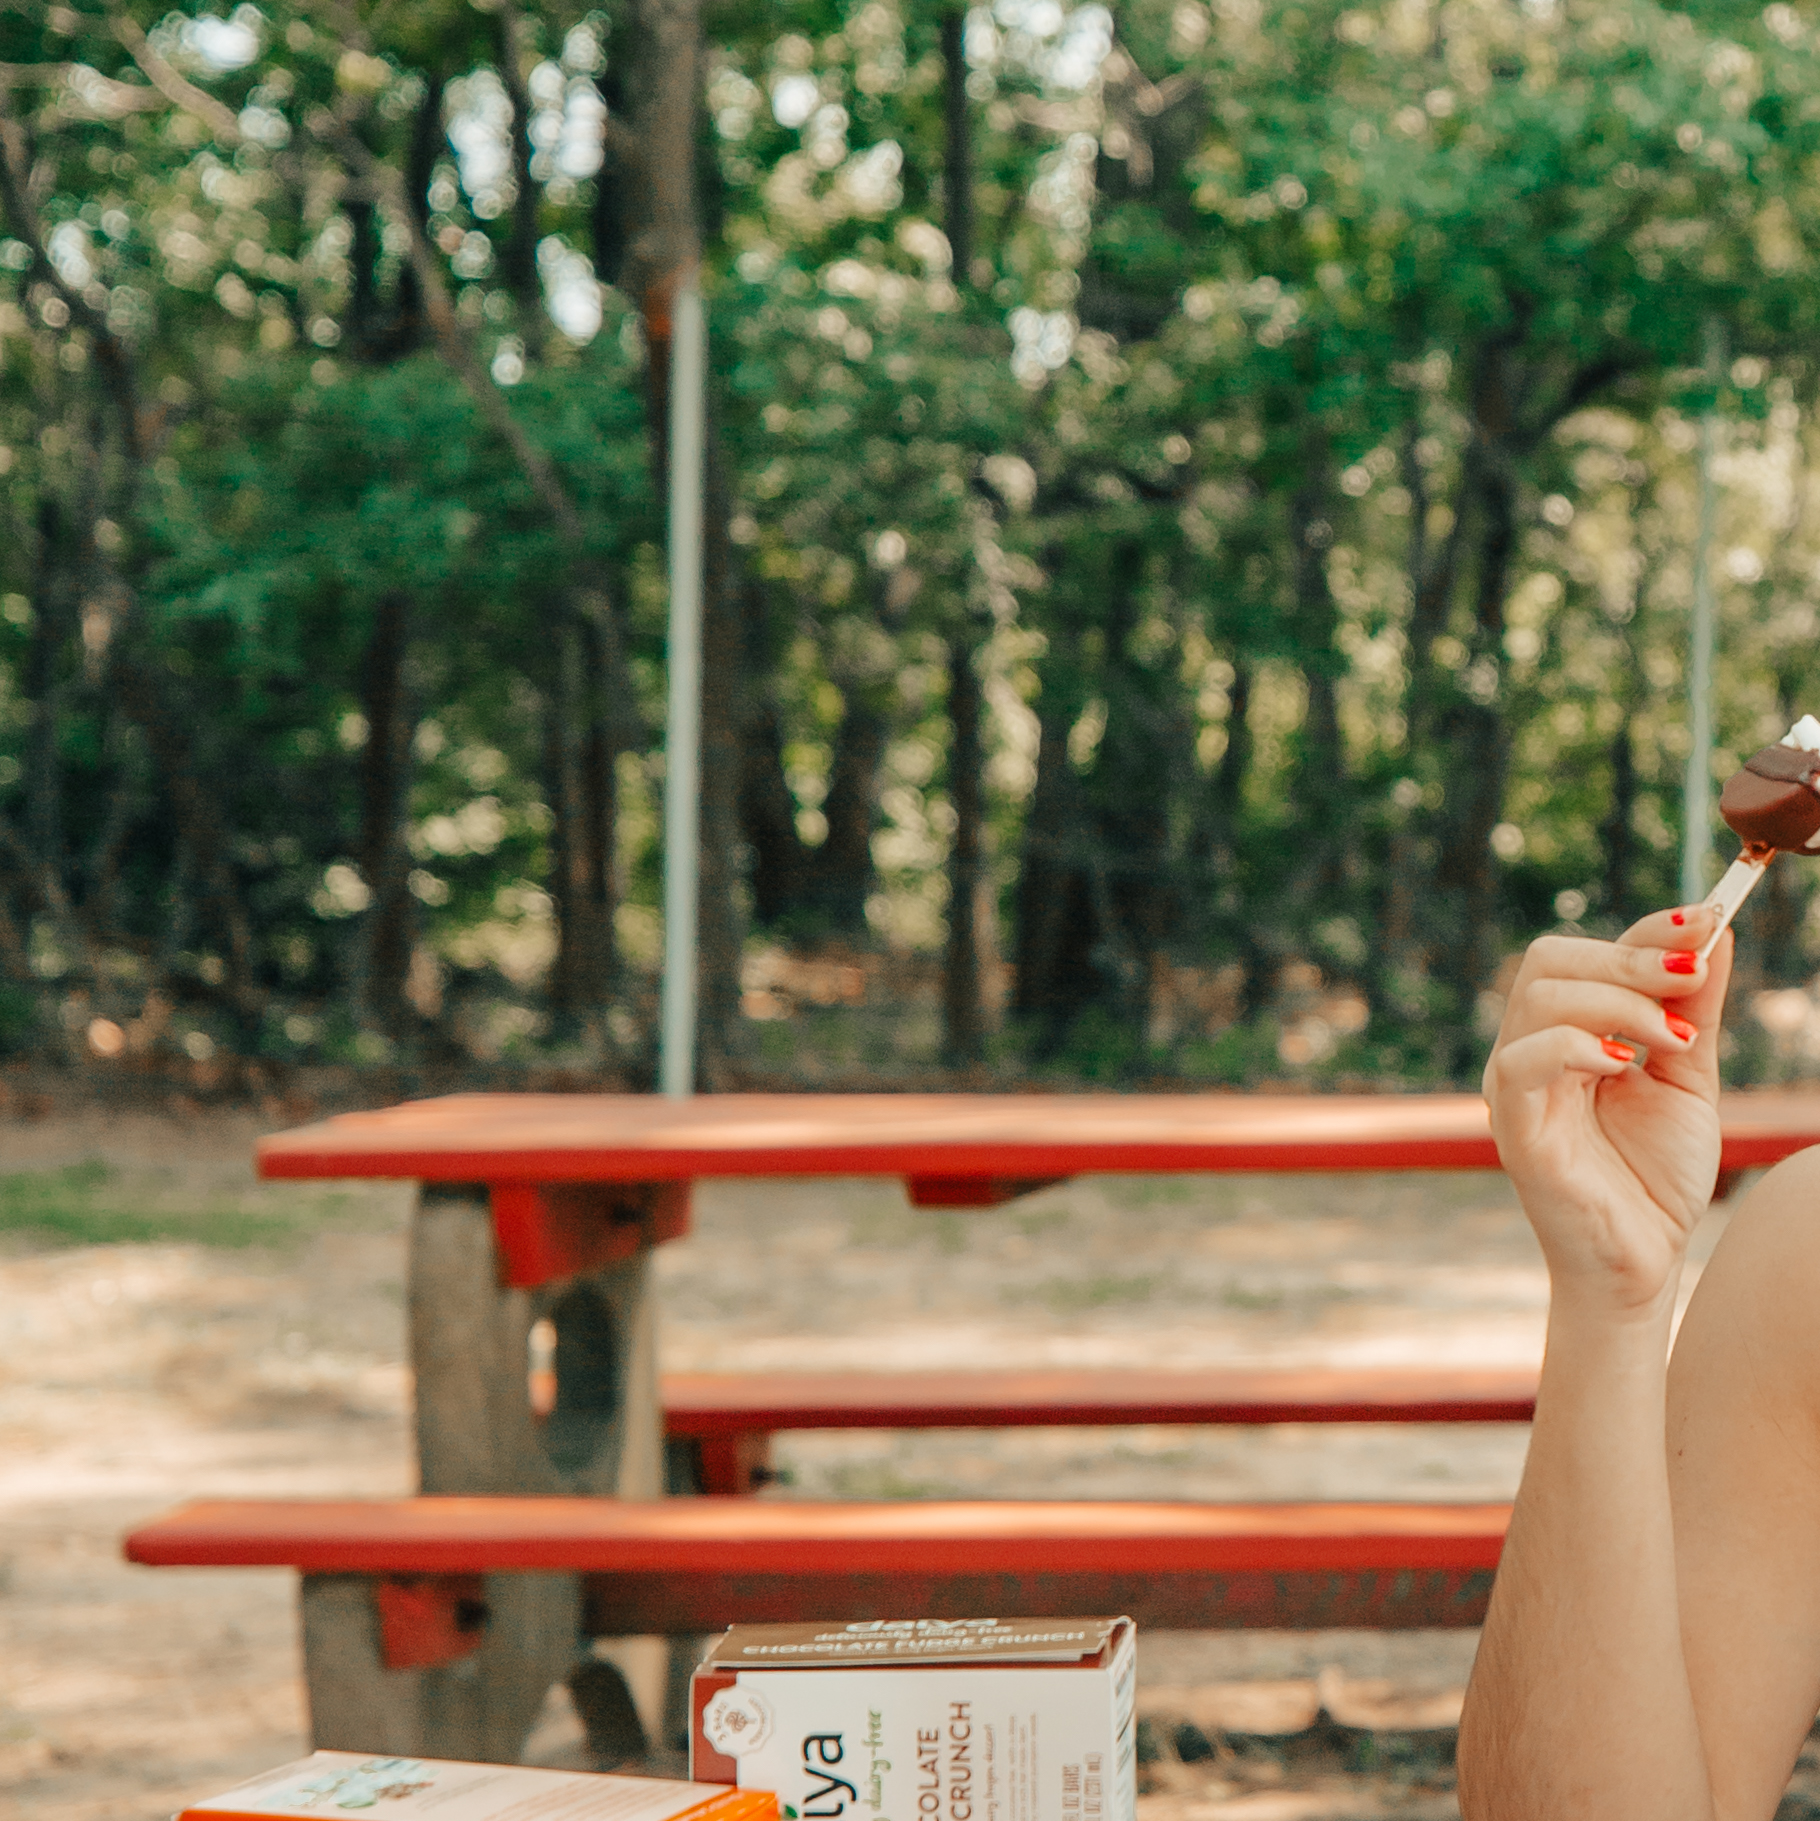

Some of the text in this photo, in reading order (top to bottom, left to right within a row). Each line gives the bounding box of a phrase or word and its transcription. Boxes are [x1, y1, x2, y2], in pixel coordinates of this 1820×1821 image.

[742, 1640, 889, 1655] CHOCOLATE
[894, 1636, 975, 1650] FUDGE
[980, 1630, 1086, 1645] CRUNCH
[861, 1704, 893, 1812] dairy-free
